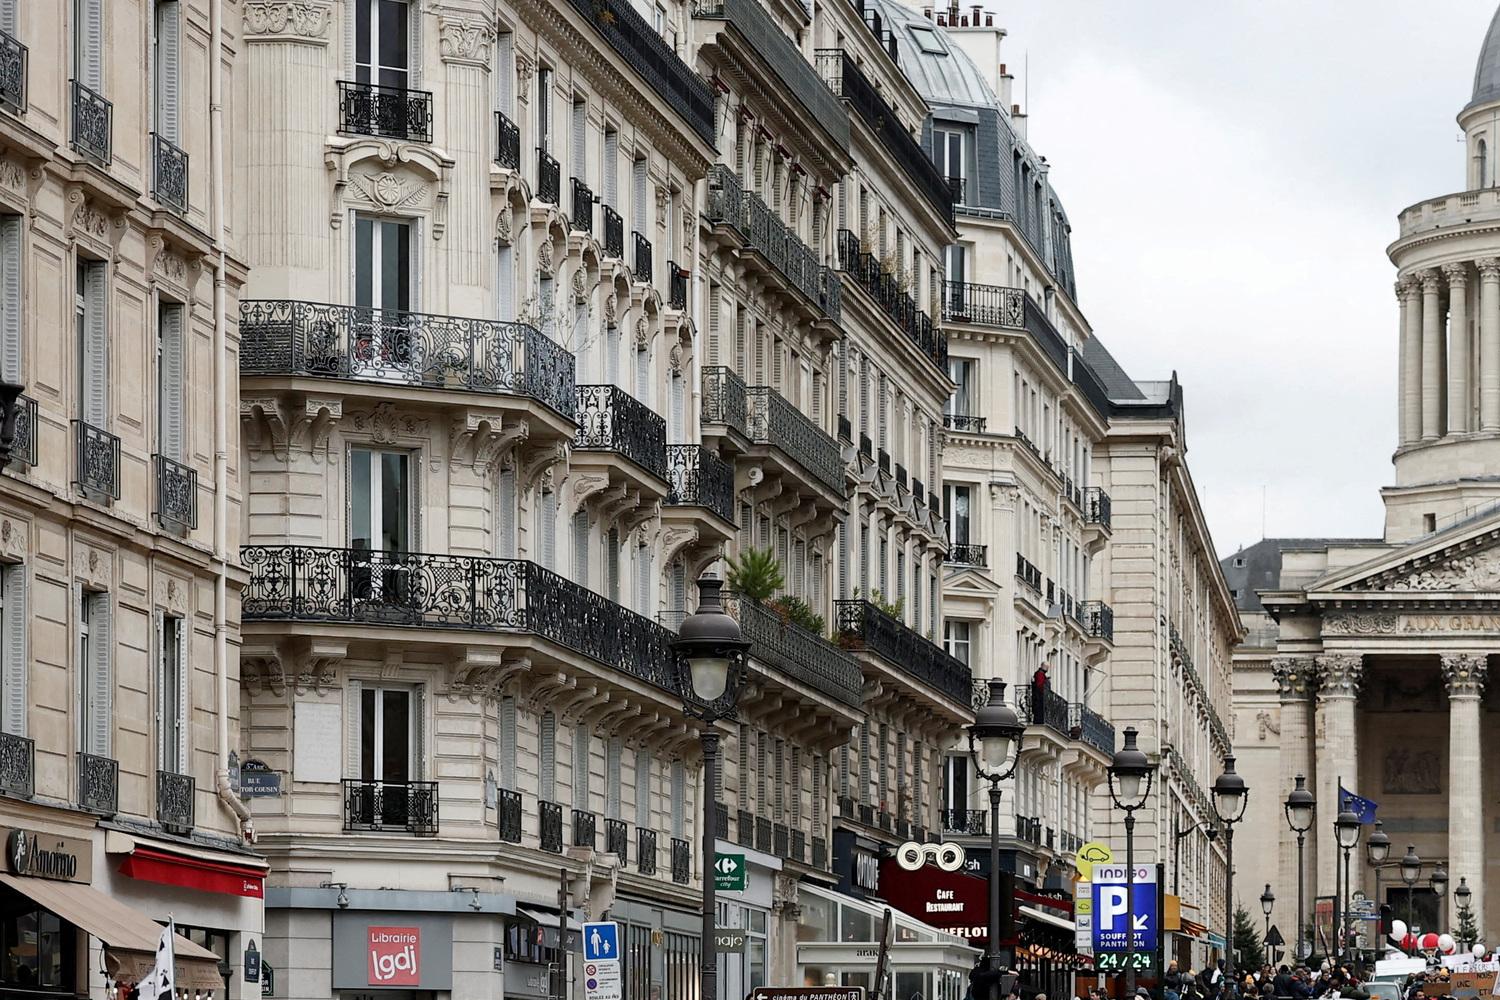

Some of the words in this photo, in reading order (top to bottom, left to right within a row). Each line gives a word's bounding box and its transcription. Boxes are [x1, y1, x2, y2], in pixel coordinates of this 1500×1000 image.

[1403, 616, 1444, 632] AUX
[30, 834, 77, 878] Amorino
[926, 902, 964, 912] RESTAURANT
[1100, 886, 1128, 930] P
[371, 932, 417, 943] Librairie
[1100, 932, 1142, 940] SOUFFOT
[372, 944, 417, 980] lgdj
[1099, 953, 1118, 969] 24
[1132, 953, 1151, 969] 24
[810, 992, 848, 1000] PANTHÉON
